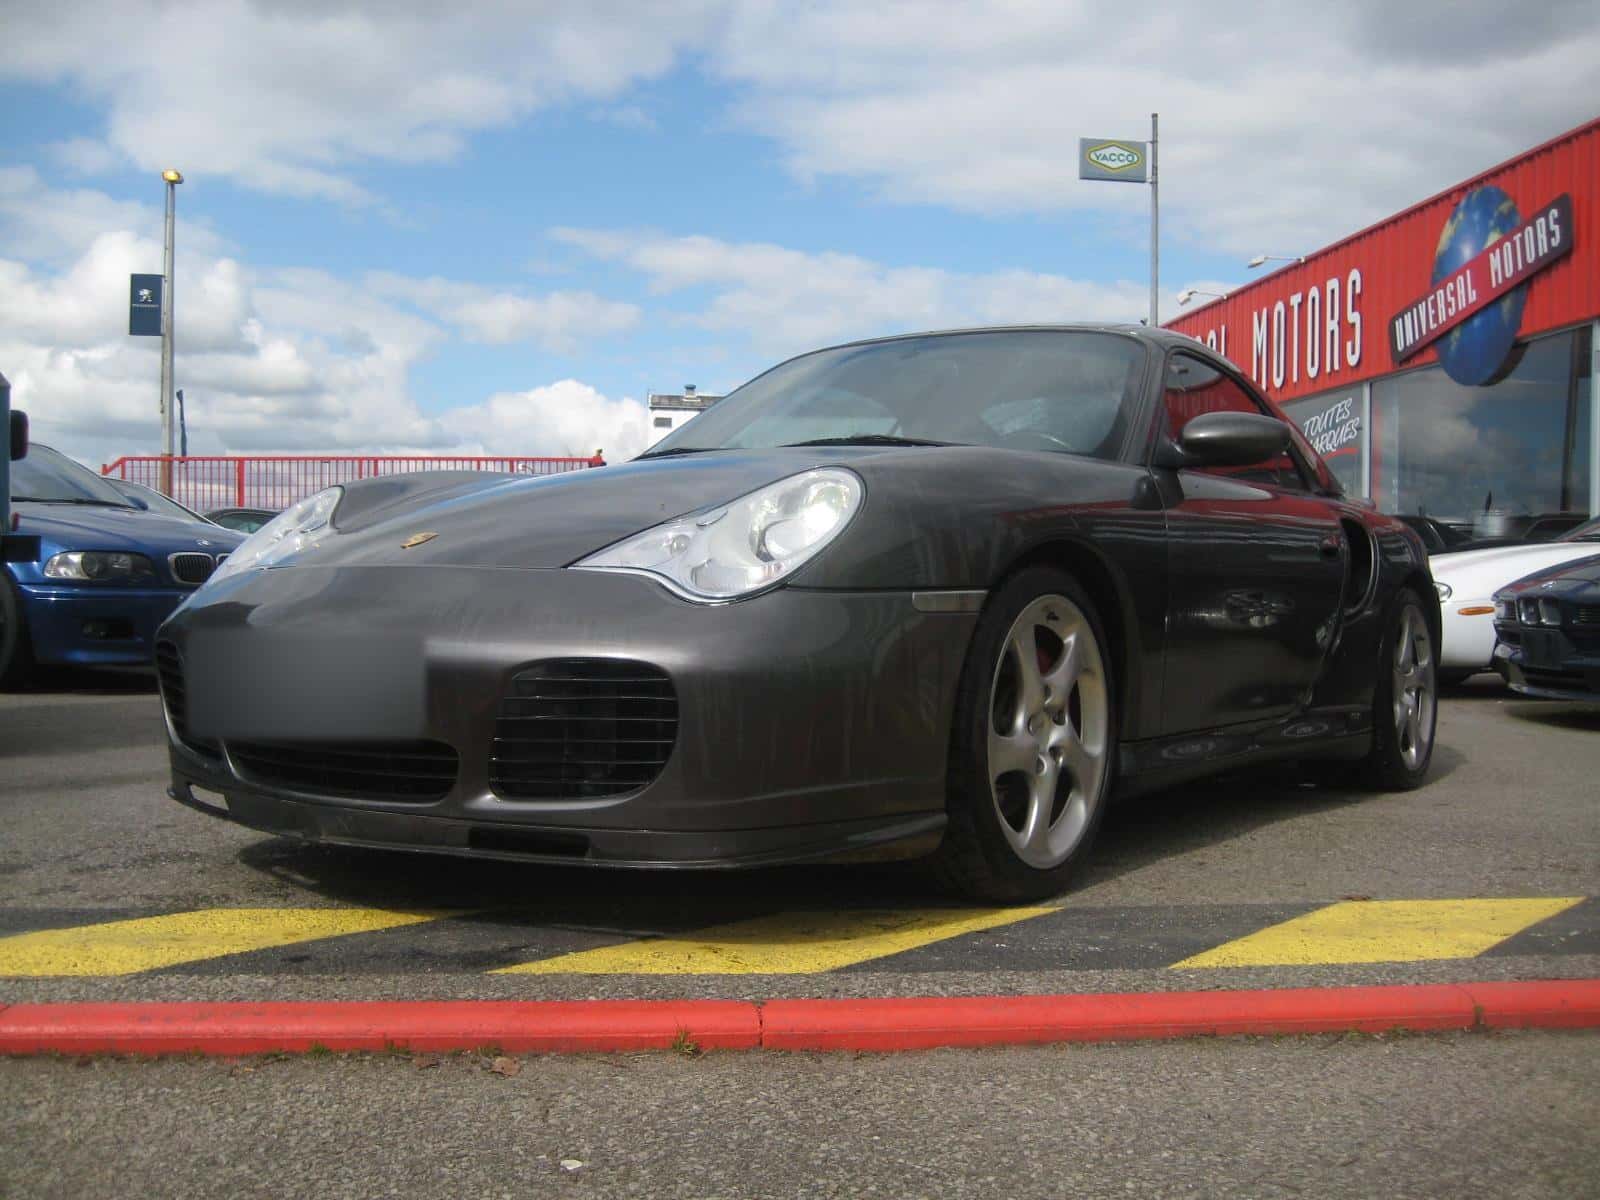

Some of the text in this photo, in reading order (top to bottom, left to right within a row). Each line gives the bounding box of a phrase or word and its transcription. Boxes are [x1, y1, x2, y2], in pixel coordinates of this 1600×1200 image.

[1094, 152, 1136, 163] YACCO
[1394, 208, 1561, 352] UNIVERSAL MOTORS
[1252, 268, 1362, 392] MOTORS
[1304, 397, 1353, 437] TOUTES
[1310, 416, 1360, 455] ARQUES
